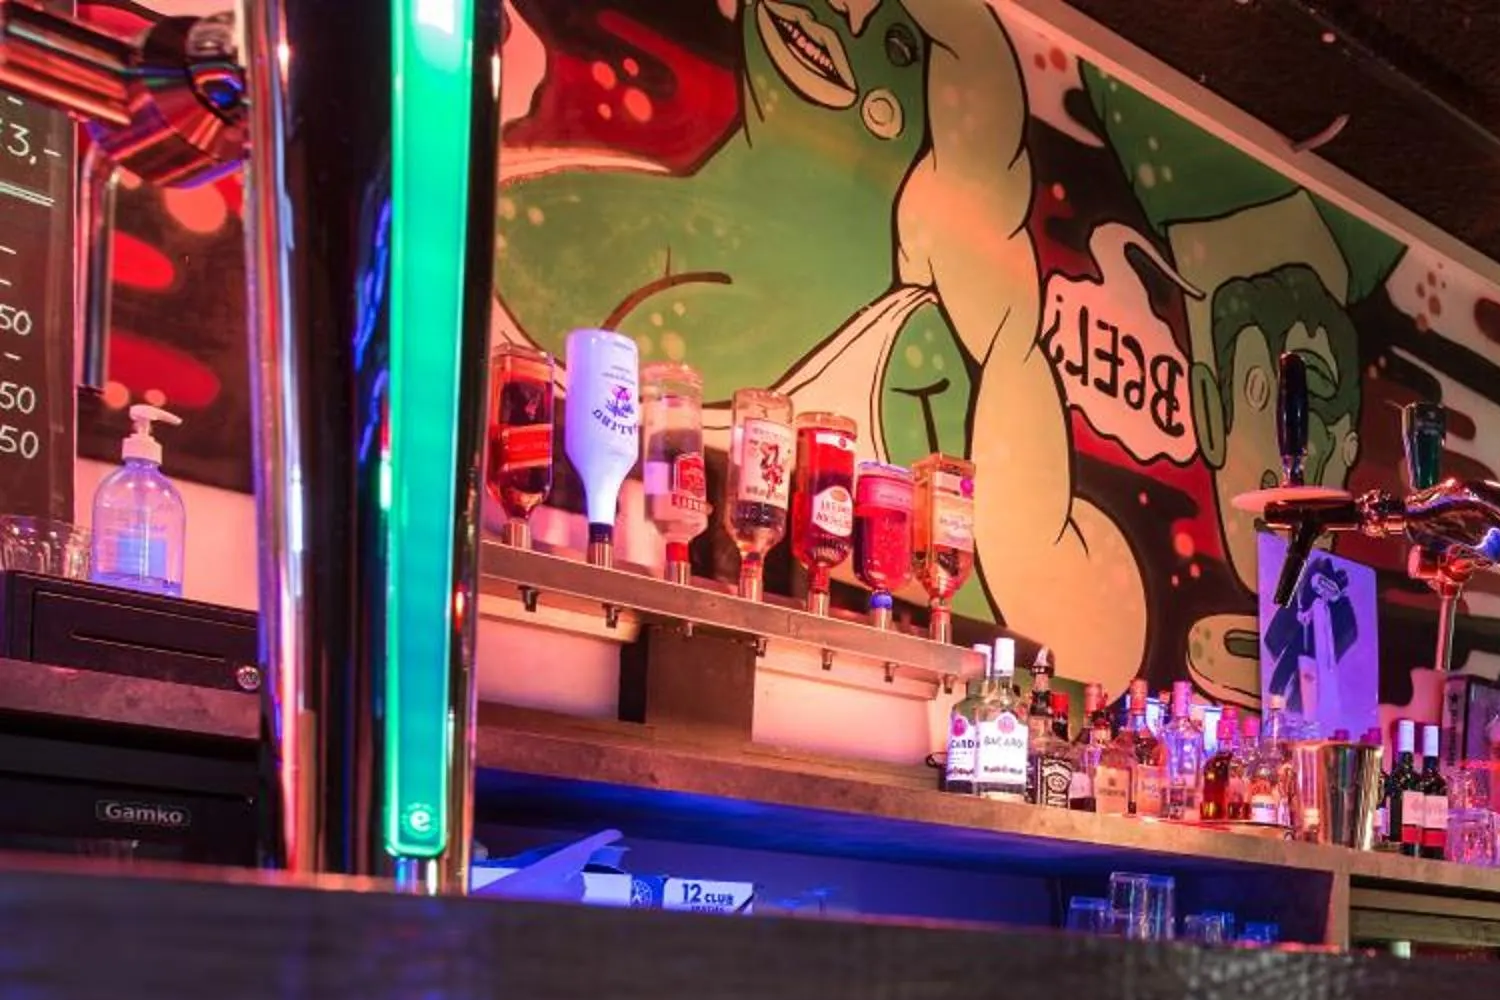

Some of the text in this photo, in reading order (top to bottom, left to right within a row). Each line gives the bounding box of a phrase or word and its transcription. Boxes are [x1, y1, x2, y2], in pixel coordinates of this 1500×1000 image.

[105, 802, 184, 824] Gamko
[681, 883, 735, 906] 12 CLUB
